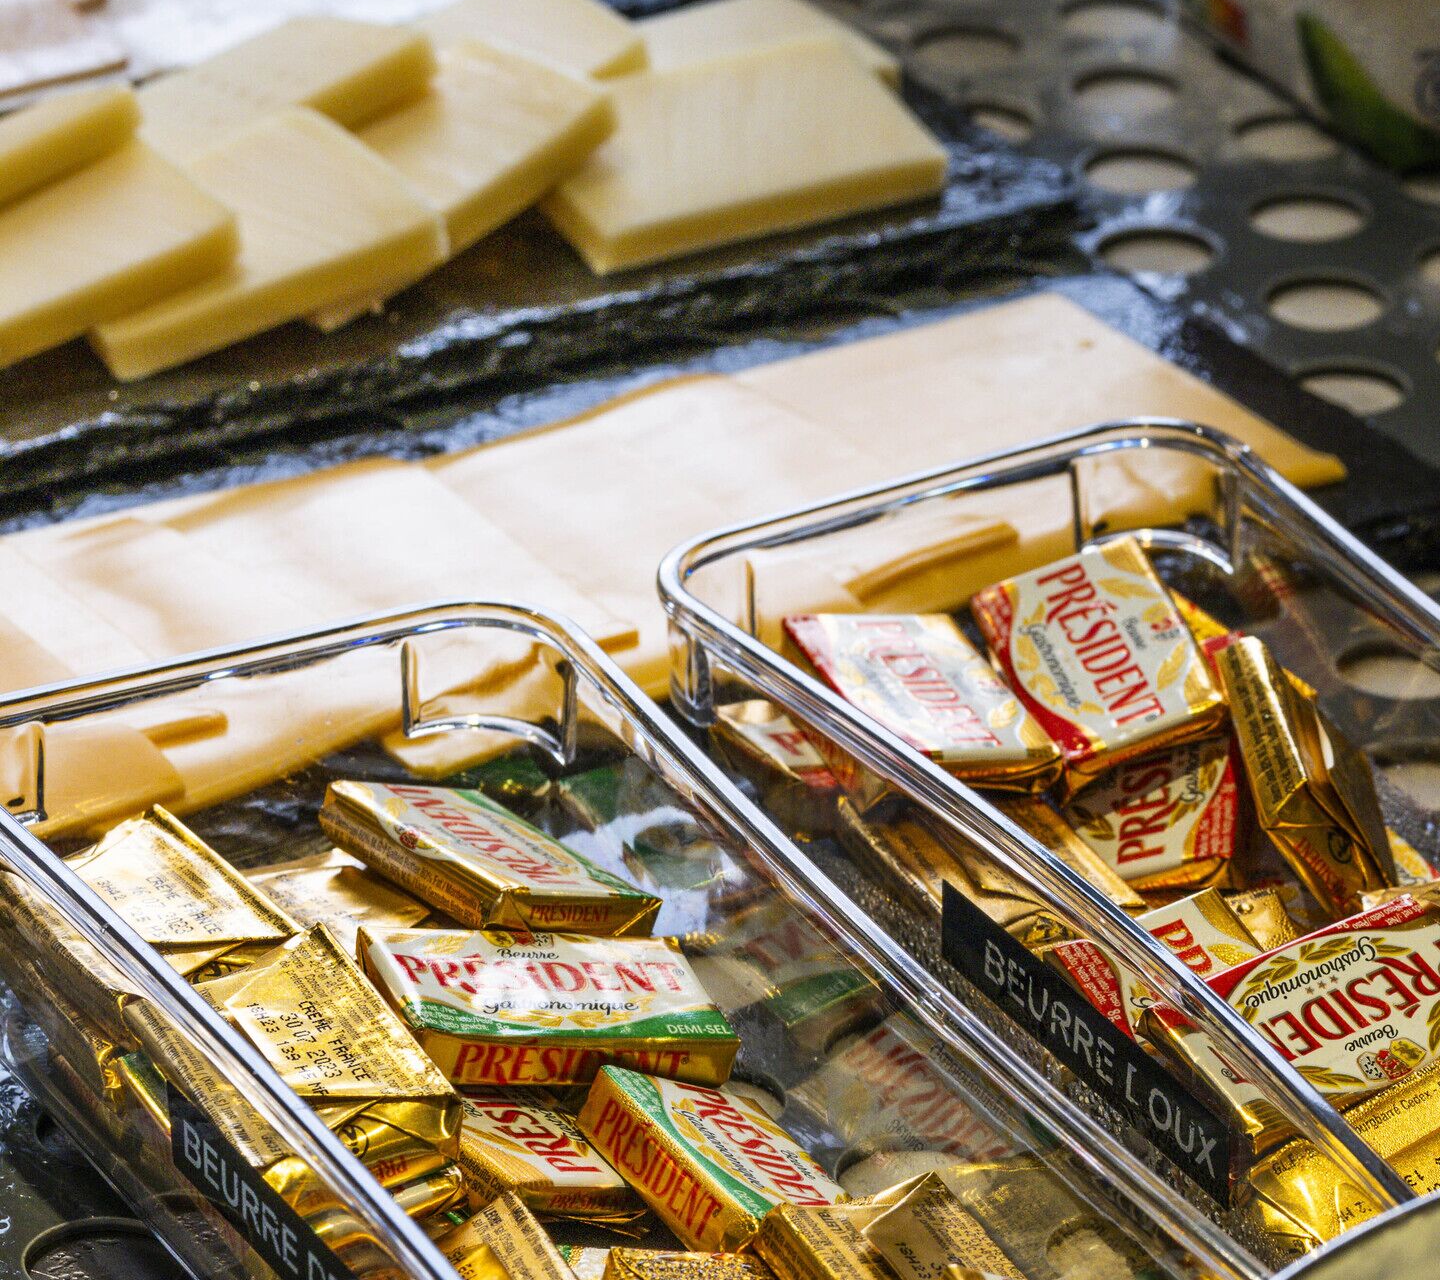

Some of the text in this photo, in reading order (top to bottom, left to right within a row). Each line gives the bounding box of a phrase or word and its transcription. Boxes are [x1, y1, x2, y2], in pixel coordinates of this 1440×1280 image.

[855, 620, 1003, 748] PRÉSIDENT
[1036, 561, 1165, 727] PRÉSIDENT
[390, 784, 577, 885] PRÉSIDENT
[496, 948, 559, 962] Beurre
[1246, 936, 1379, 1011] Gastronomique
[280, 1011, 344, 1080] 30 07 2023
[299, 1000, 372, 1084] CREME FRANCE
[666, 1023, 732, 1036] DEMI-SEL
[984, 938, 1117, 1086] BEURRE
[1345, 1024, 1399, 1053] Beurre
[452, 1039, 686, 1083] PRÉSIDENT
[476, 1096, 602, 1174] PRÉSI
[592, 1096, 724, 1239] PRÉSIDENT
[676, 1081, 832, 1205] PRÉSIDEN
[183, 1119, 298, 1270] BEURRE
